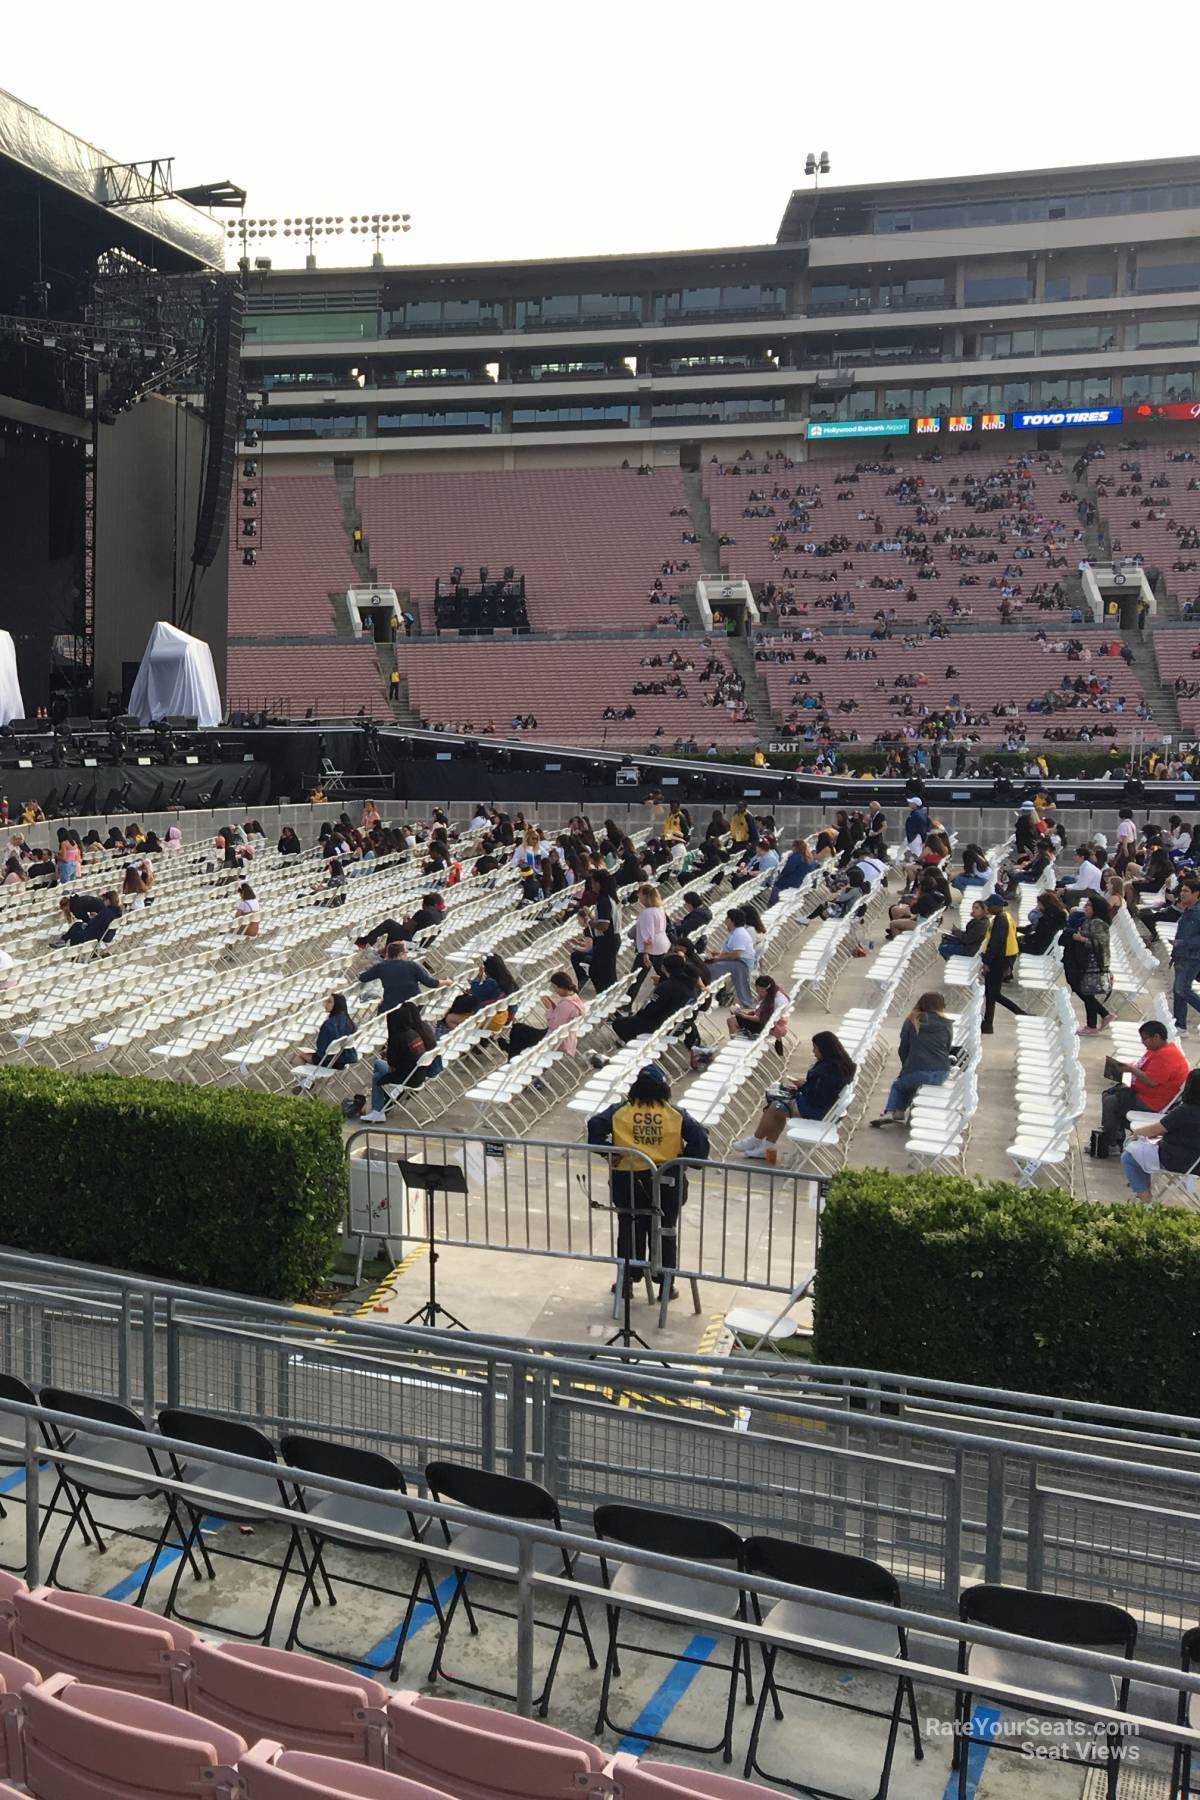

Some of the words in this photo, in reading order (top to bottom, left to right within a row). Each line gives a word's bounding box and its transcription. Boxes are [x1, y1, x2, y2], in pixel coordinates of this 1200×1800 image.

[1022, 414, 1065, 426] TOYO
[1065, 411, 1110, 423] TIRES
[916, 425, 940, 434] KIND
[949, 424, 972, 432] KIND
[981, 422, 1005, 431] KIND
[1115, 576, 1124, 584] 19
[769, 742, 799, 753] EXIT
[633, 1112, 663, 1125] CSC
[633, 1125, 663, 1136] EVENT
[633, 1136, 663, 1145] STAFF
